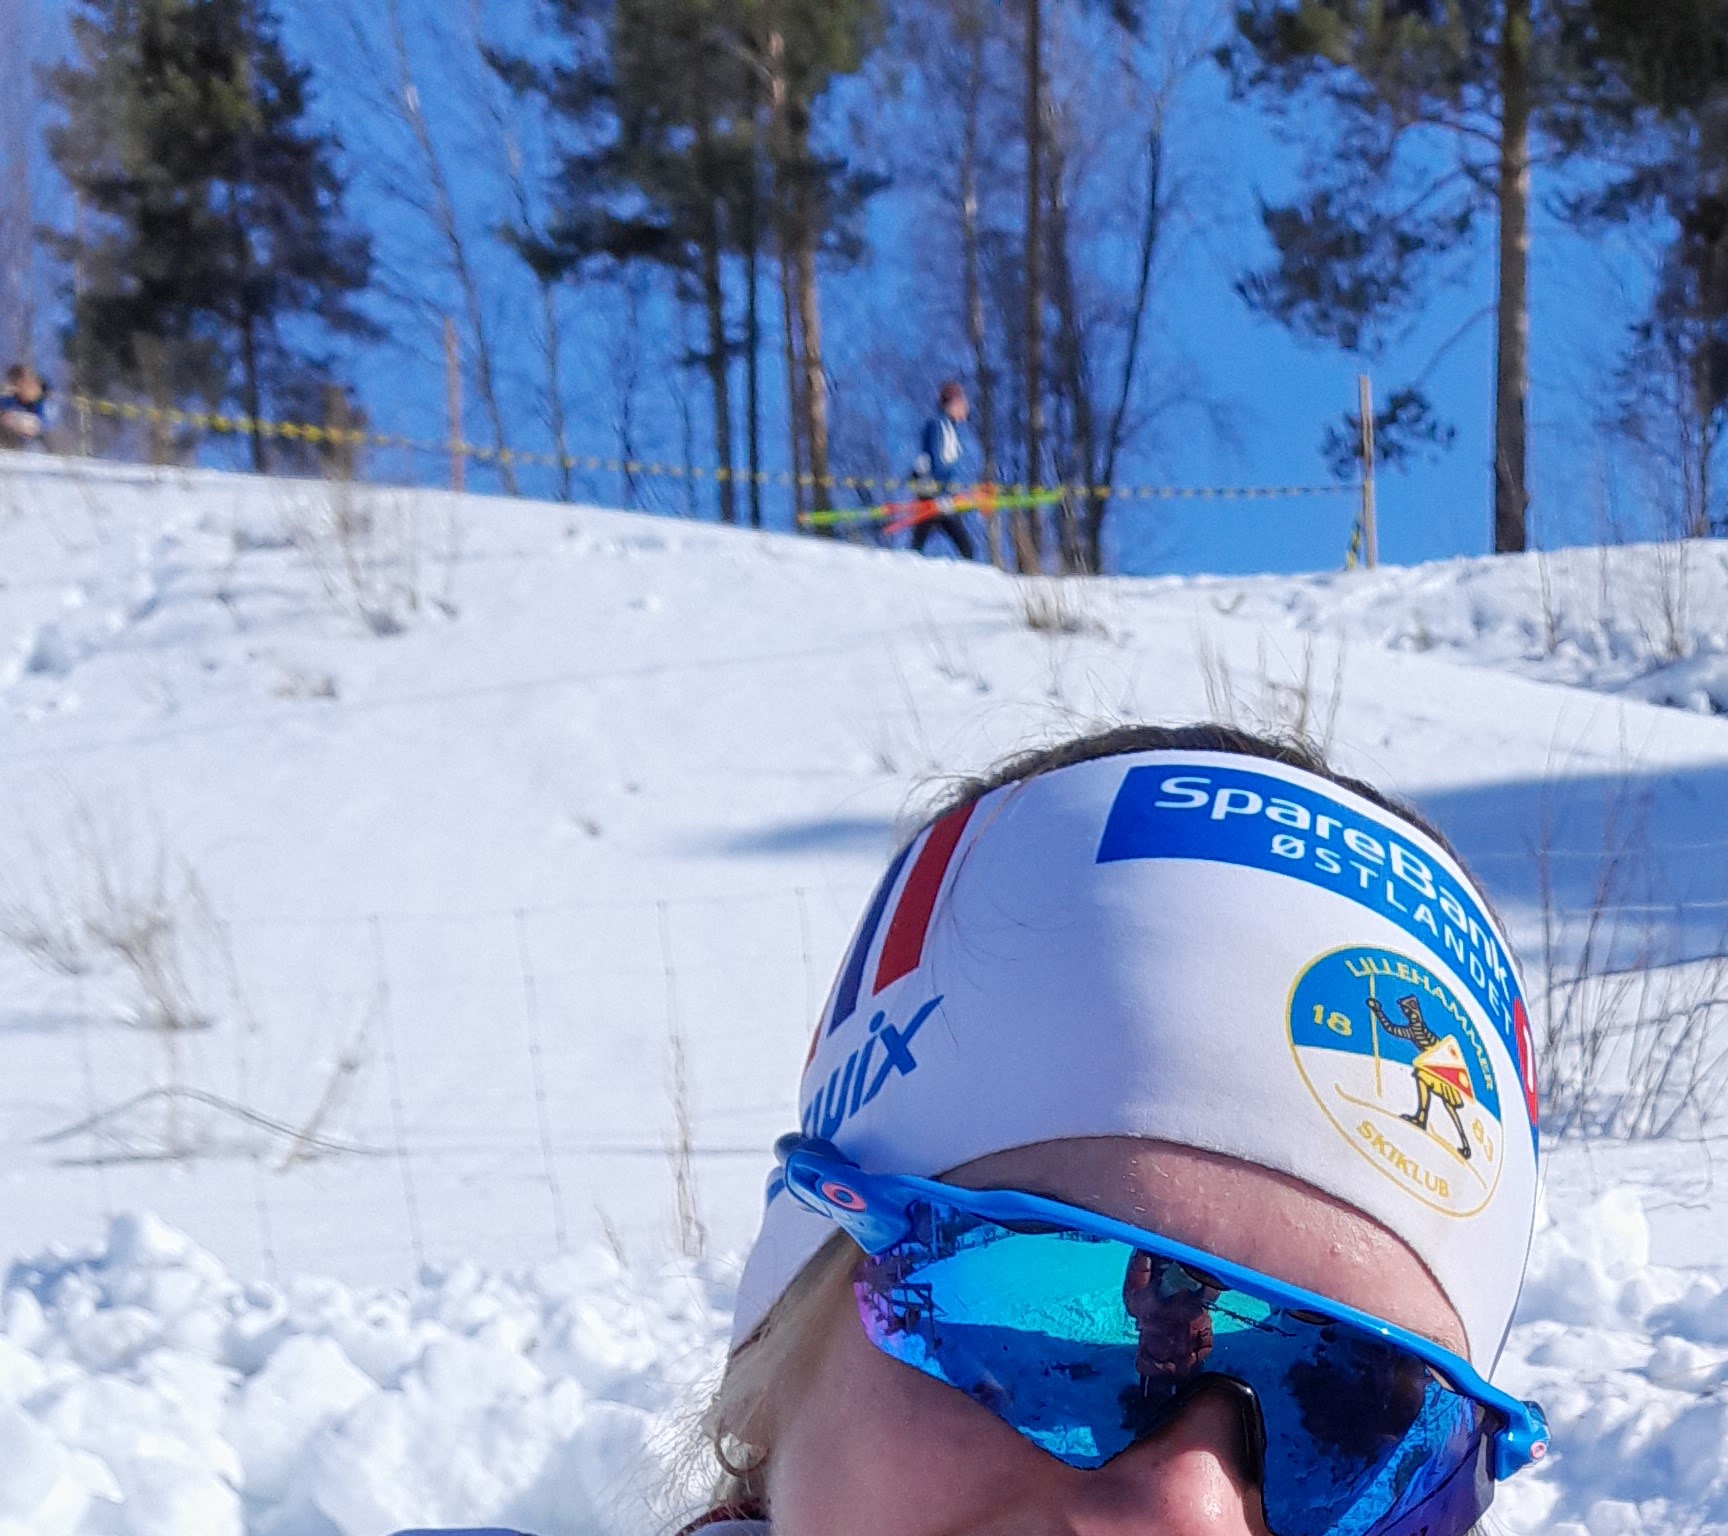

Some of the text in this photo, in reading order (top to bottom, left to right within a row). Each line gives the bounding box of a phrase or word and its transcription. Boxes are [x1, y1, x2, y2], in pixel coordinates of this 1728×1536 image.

[1154, 776, 1511, 1003] SpareBank
[1271, 833, 1513, 1036] ØSTLANDET
[1312, 1004, 1353, 1036] 18
[1345, 957, 1493, 1091] LILLEHAMMER
[1357, 1120, 1449, 1198] SKIKLUB
